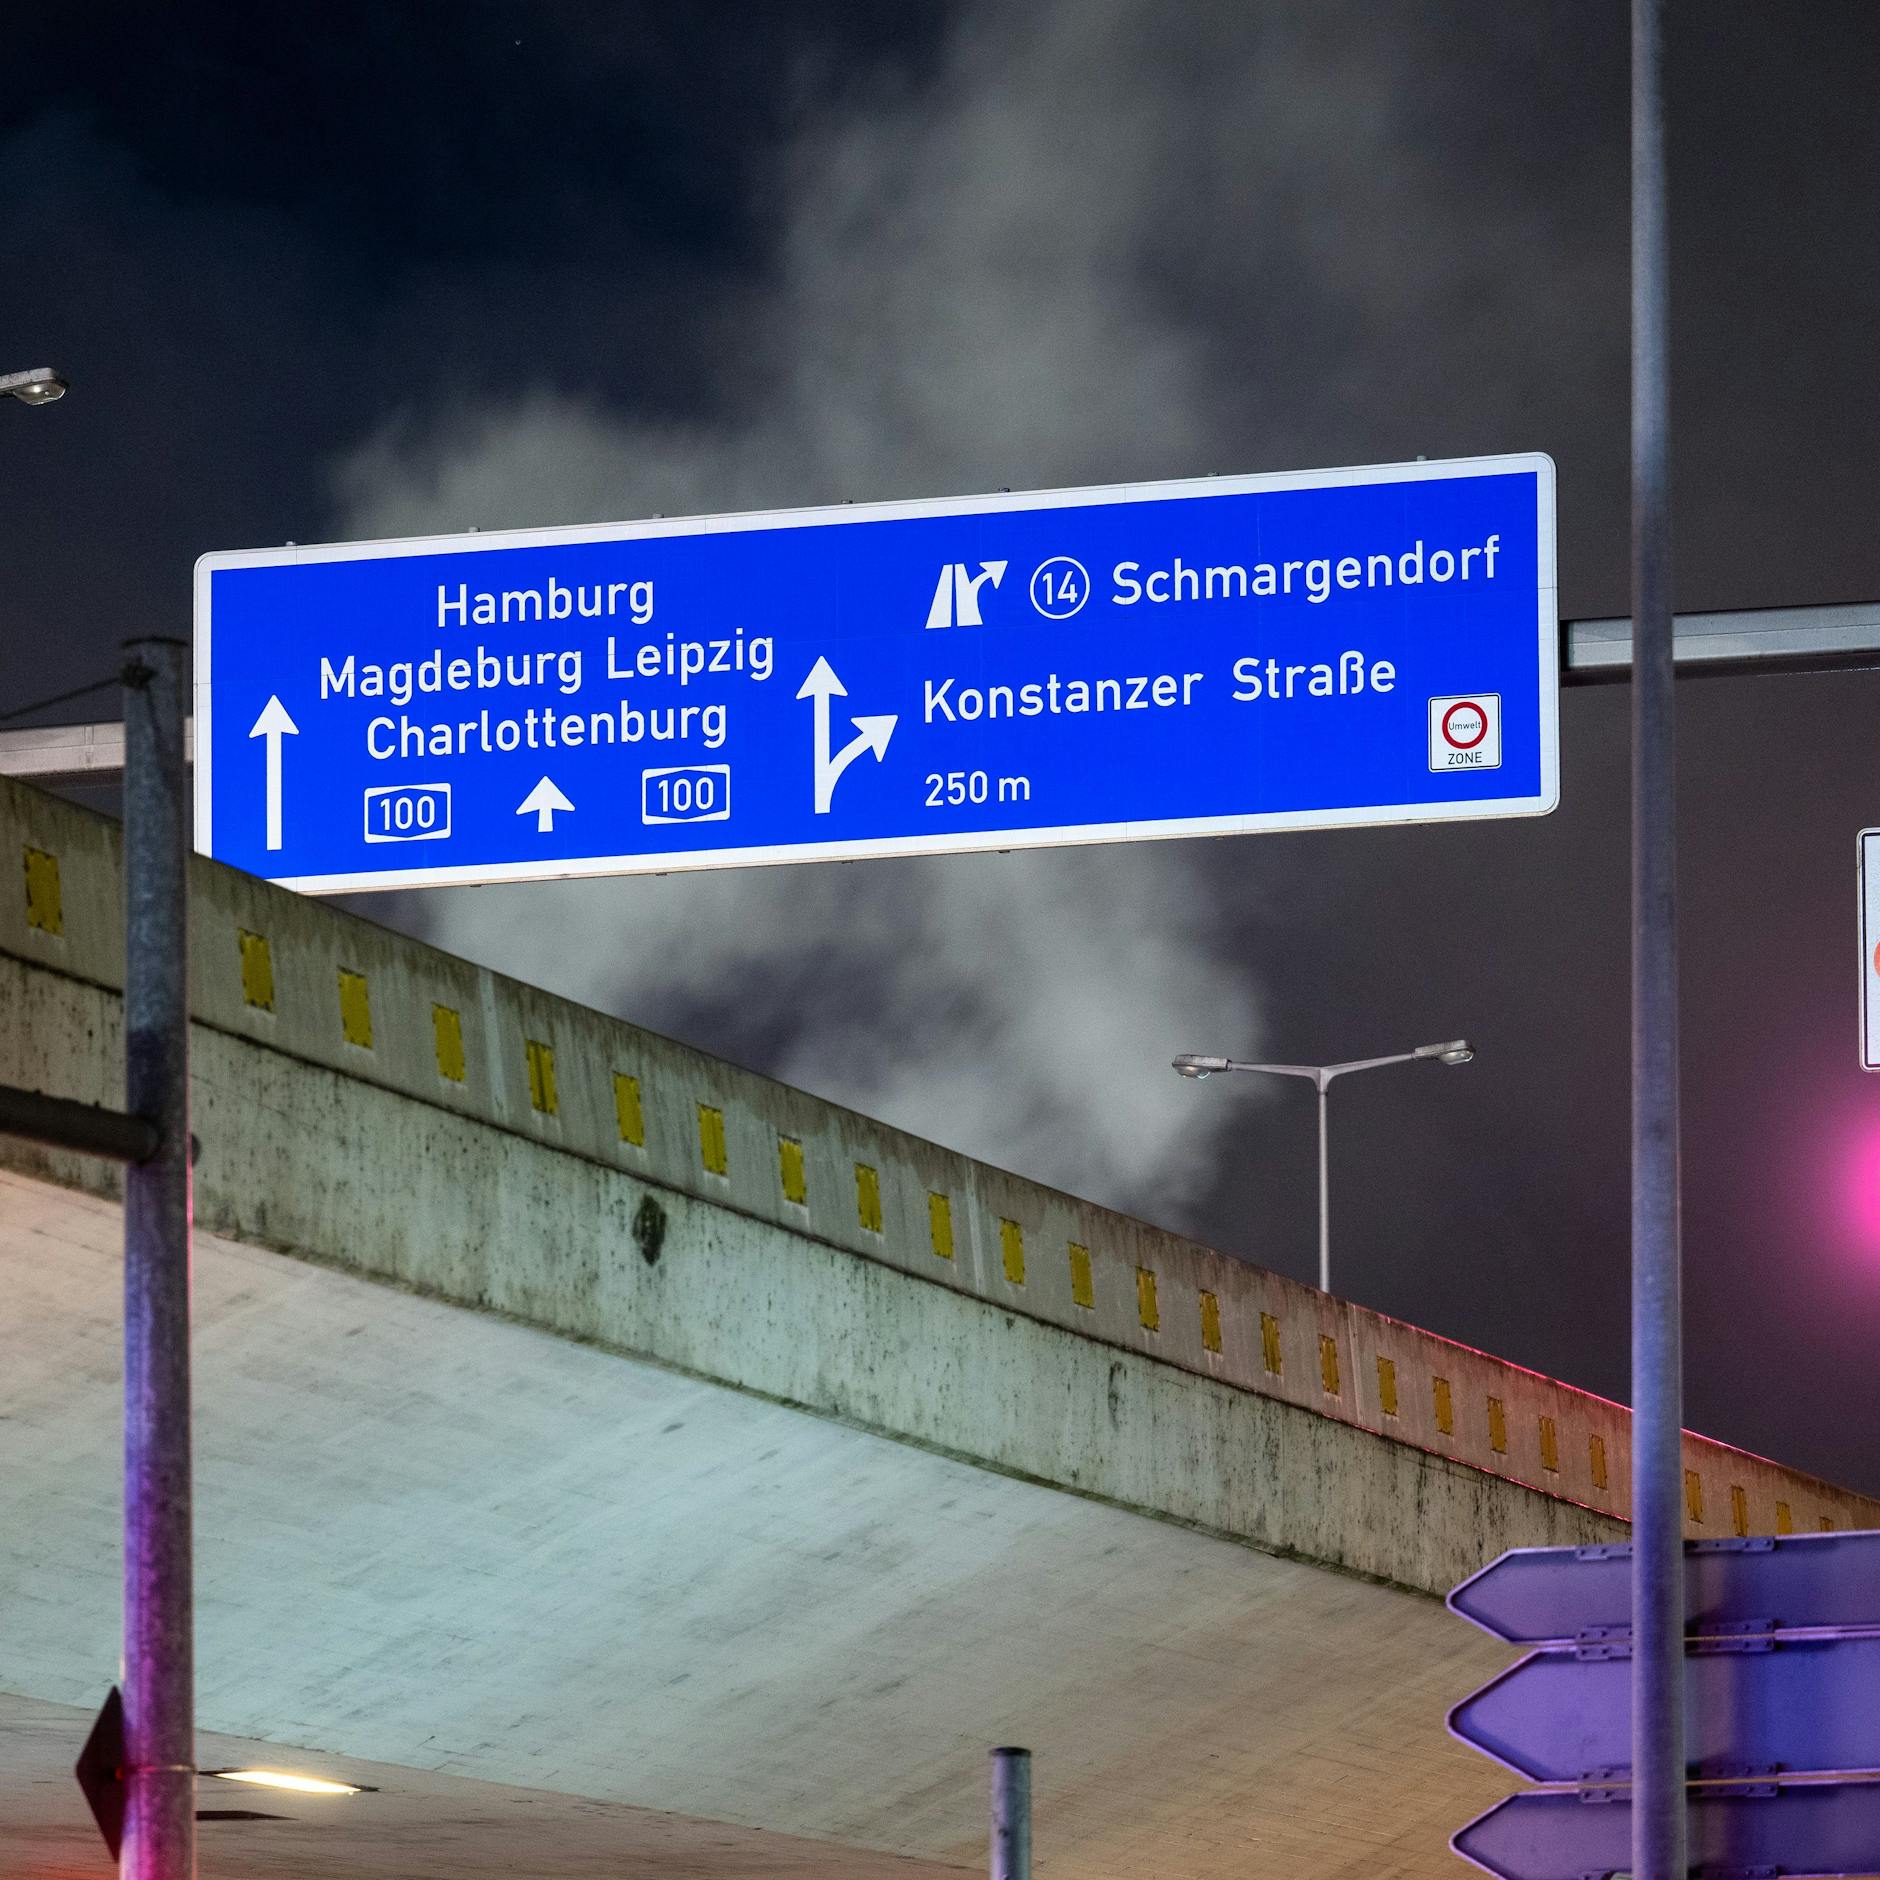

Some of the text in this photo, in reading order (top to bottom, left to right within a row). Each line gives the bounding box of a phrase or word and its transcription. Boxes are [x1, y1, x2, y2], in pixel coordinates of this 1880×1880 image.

[1042, 534, 1500, 605] 14 Schmargendorf
[437, 576, 655, 628] Hamburg
[320, 627, 774, 706] Magdeburg Leipzig
[924, 650, 1396, 724] Konstanzer Straße
[367, 699, 727, 760] Charlottenburg
[1448, 720, 1481, 731] Umwelt
[1447, 751, 1483, 765] ZONE
[658, 776, 714, 812] 100
[925, 770, 1030, 807] 250 m
[380, 795, 435, 831] 100
